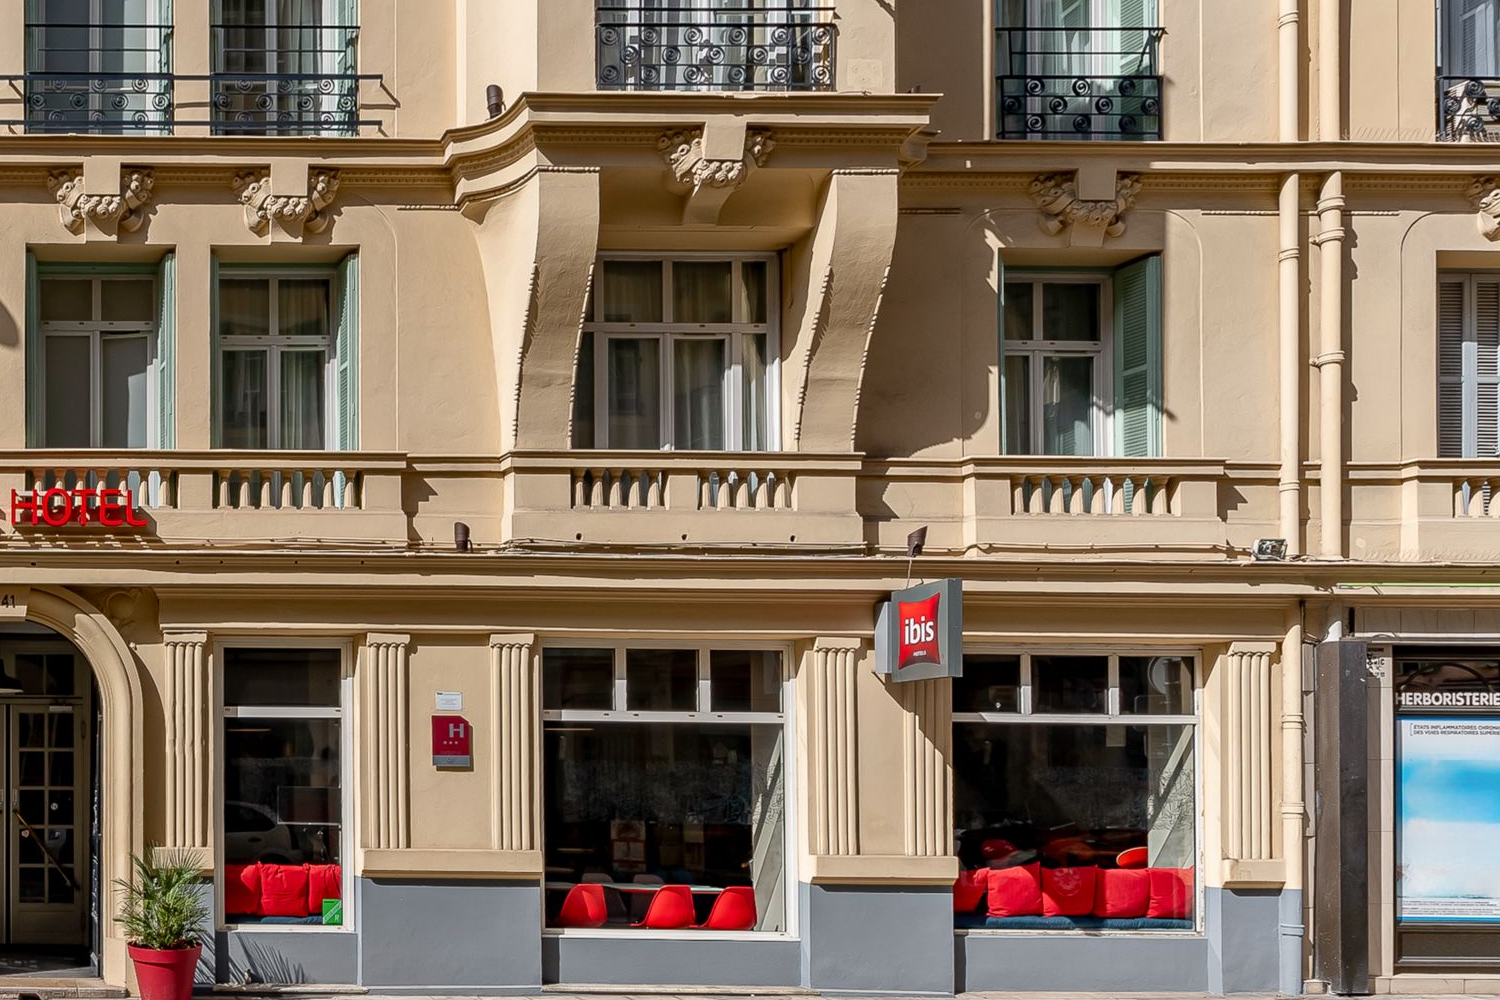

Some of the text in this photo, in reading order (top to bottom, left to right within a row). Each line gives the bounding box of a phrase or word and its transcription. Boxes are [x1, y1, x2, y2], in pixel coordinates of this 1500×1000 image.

[11, 487, 149, 527] HOTEL
[1, 594, 16, 608] 41
[904, 615, 935, 645] ibis
[1395, 692, 1500, 706] HERBORISTERIE
[449, 723, 465, 738] H
